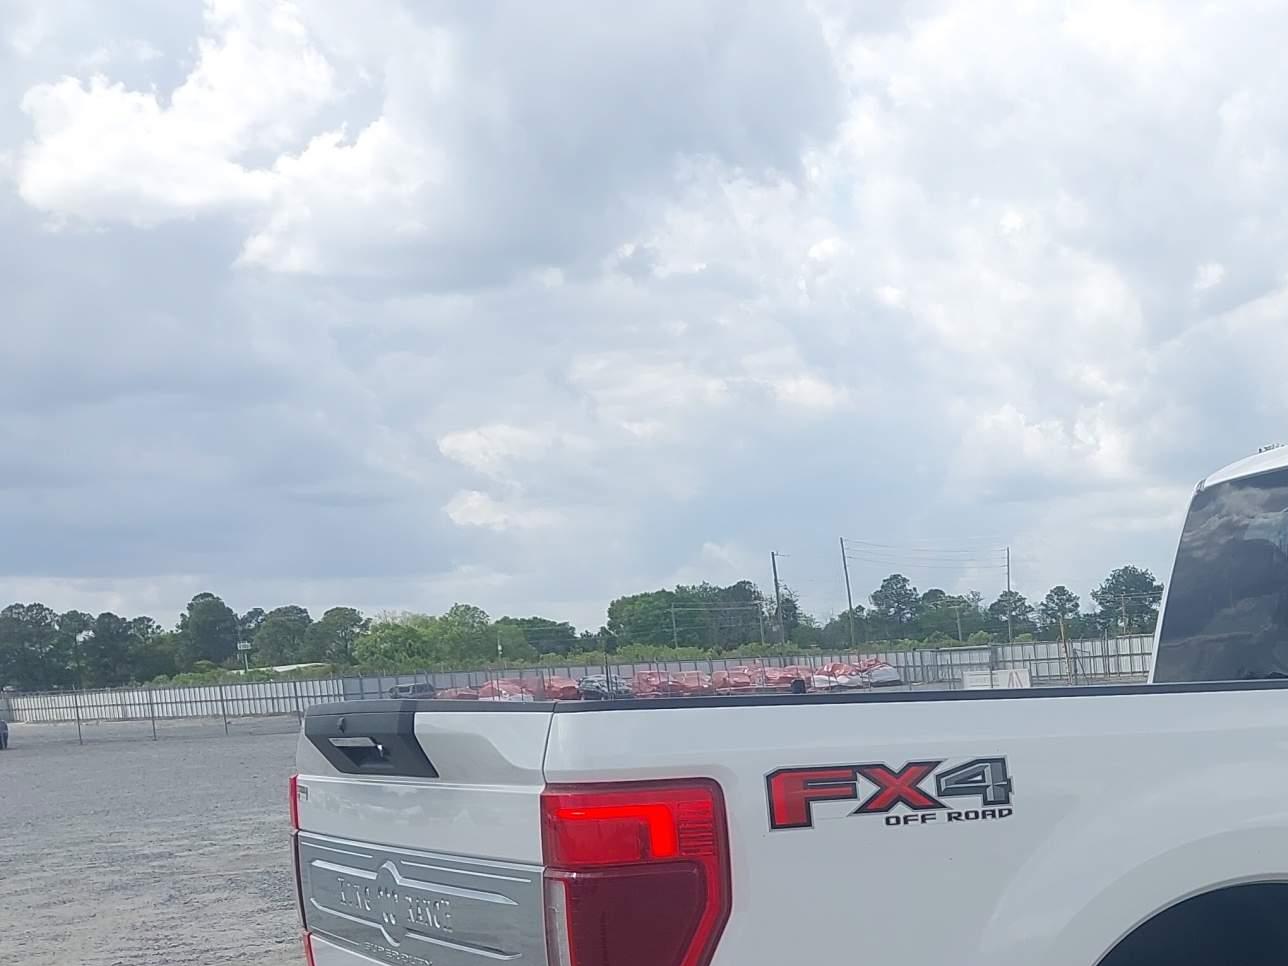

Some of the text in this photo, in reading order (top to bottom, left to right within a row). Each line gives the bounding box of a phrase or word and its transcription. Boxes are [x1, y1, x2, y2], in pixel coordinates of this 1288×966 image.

[764, 754, 1014, 831] FX4
[885, 807, 1014, 827] OFF ROAD
